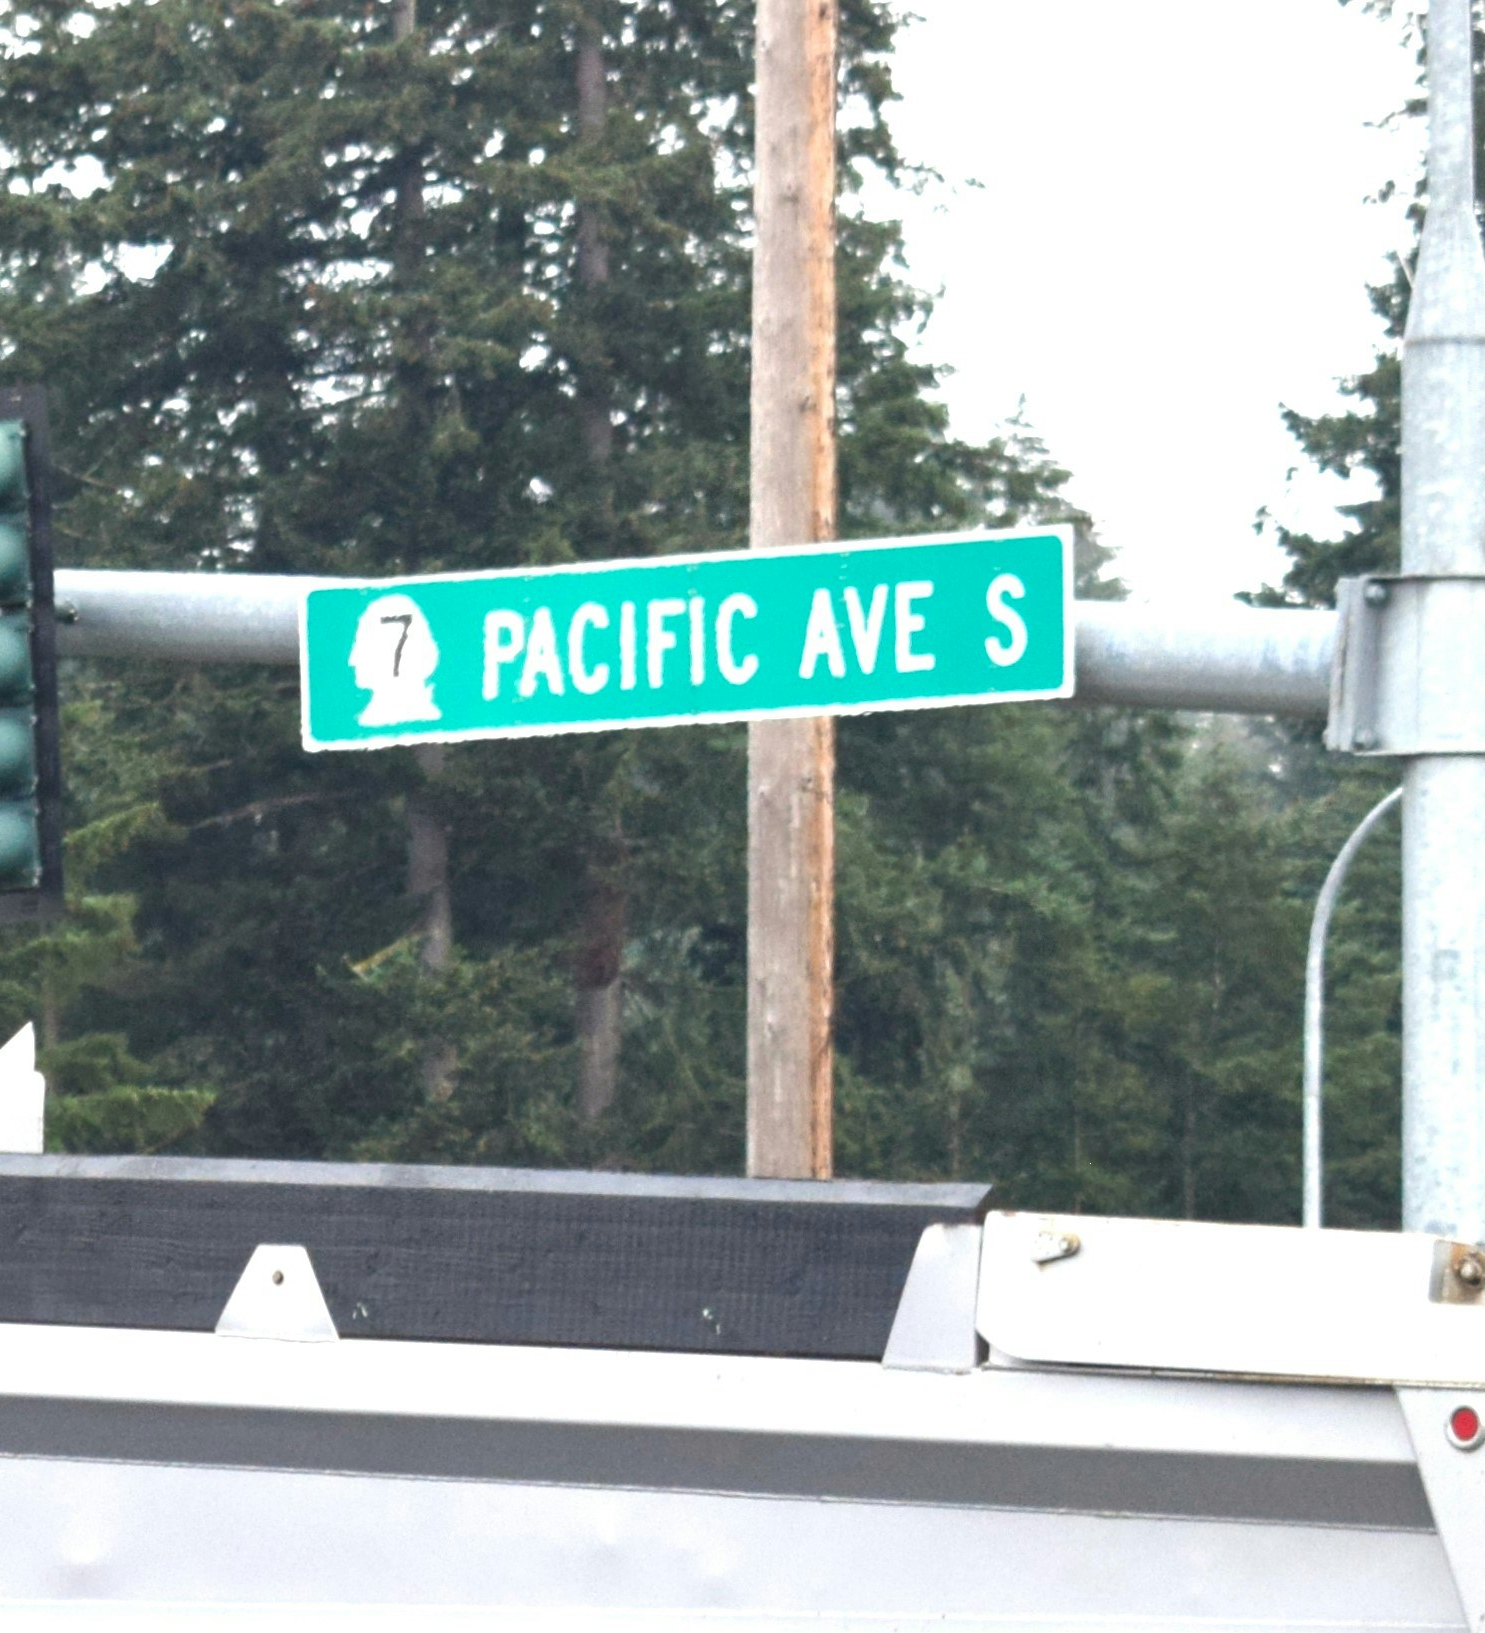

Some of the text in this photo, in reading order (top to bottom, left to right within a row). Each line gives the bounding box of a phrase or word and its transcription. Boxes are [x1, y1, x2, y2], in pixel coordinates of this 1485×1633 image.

[380, 573, 1028, 701] 7 PACIFIC AVE S
